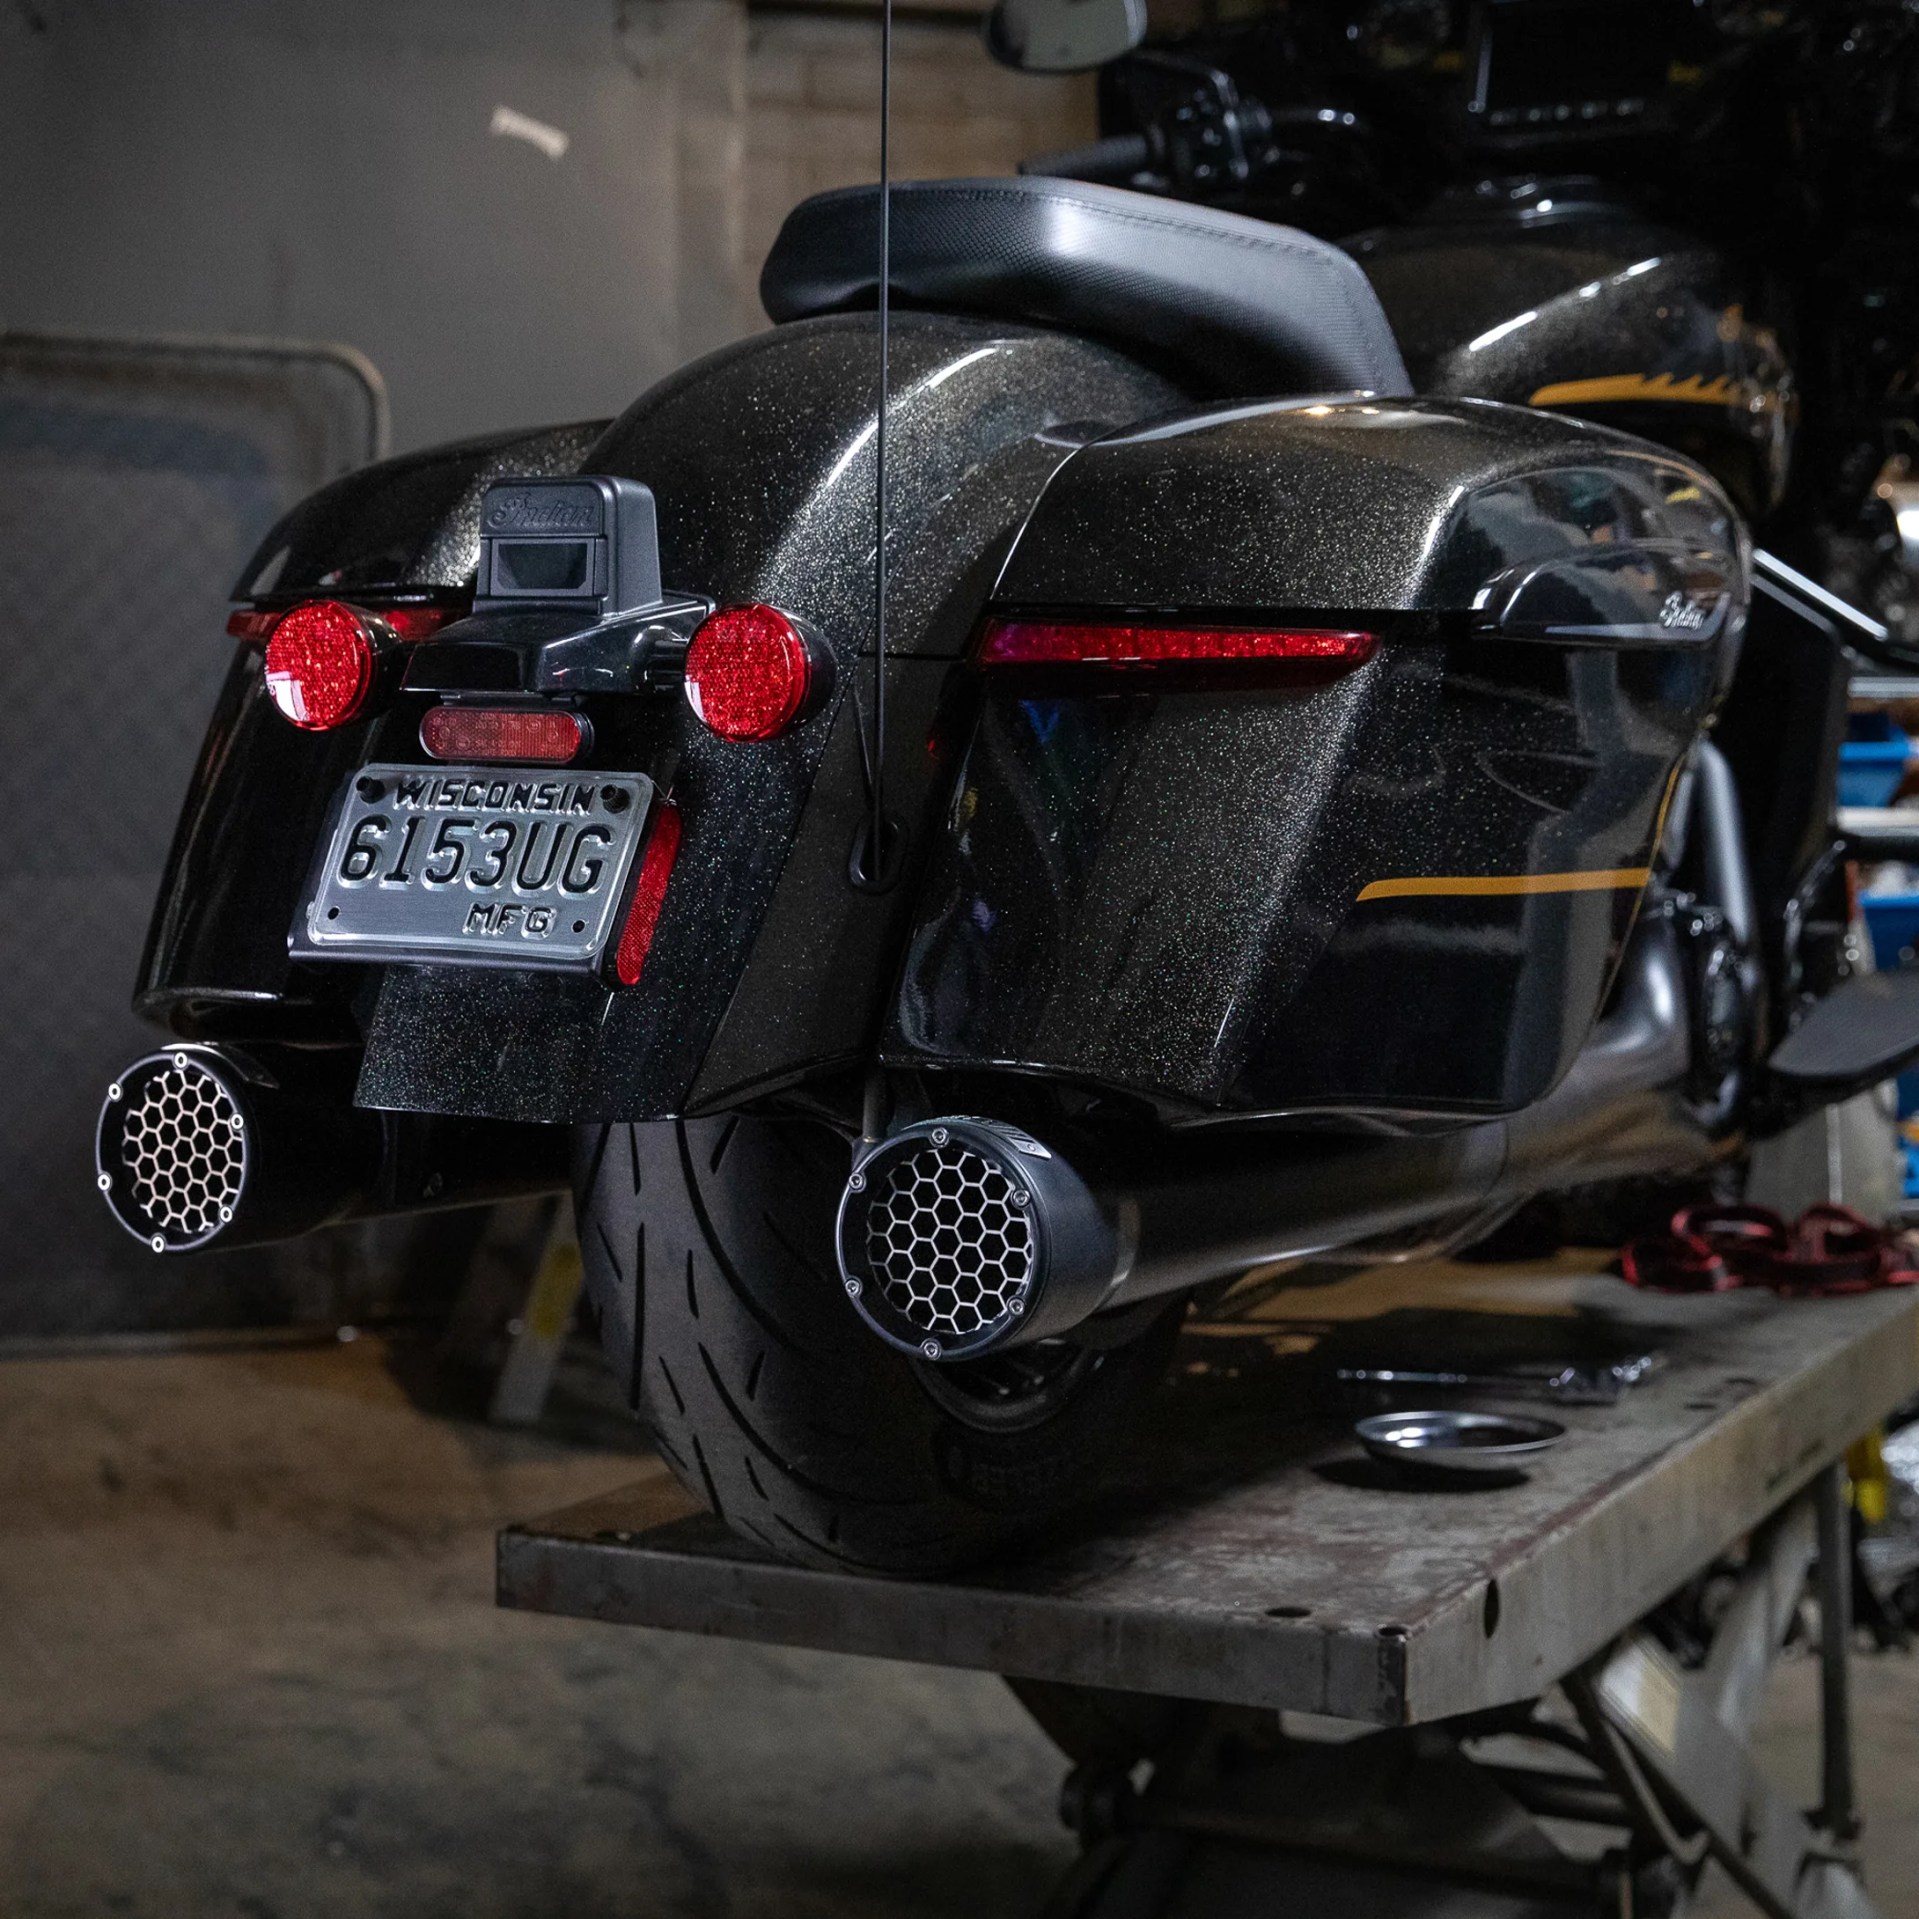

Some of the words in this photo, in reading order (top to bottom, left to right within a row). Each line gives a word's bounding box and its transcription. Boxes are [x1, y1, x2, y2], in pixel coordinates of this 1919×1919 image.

[487, 491, 596, 529] Indian
[393, 777, 597, 816] WISCONSIN
[338, 815, 614, 895] 6153UG
[462, 902, 557, 939] MFG
